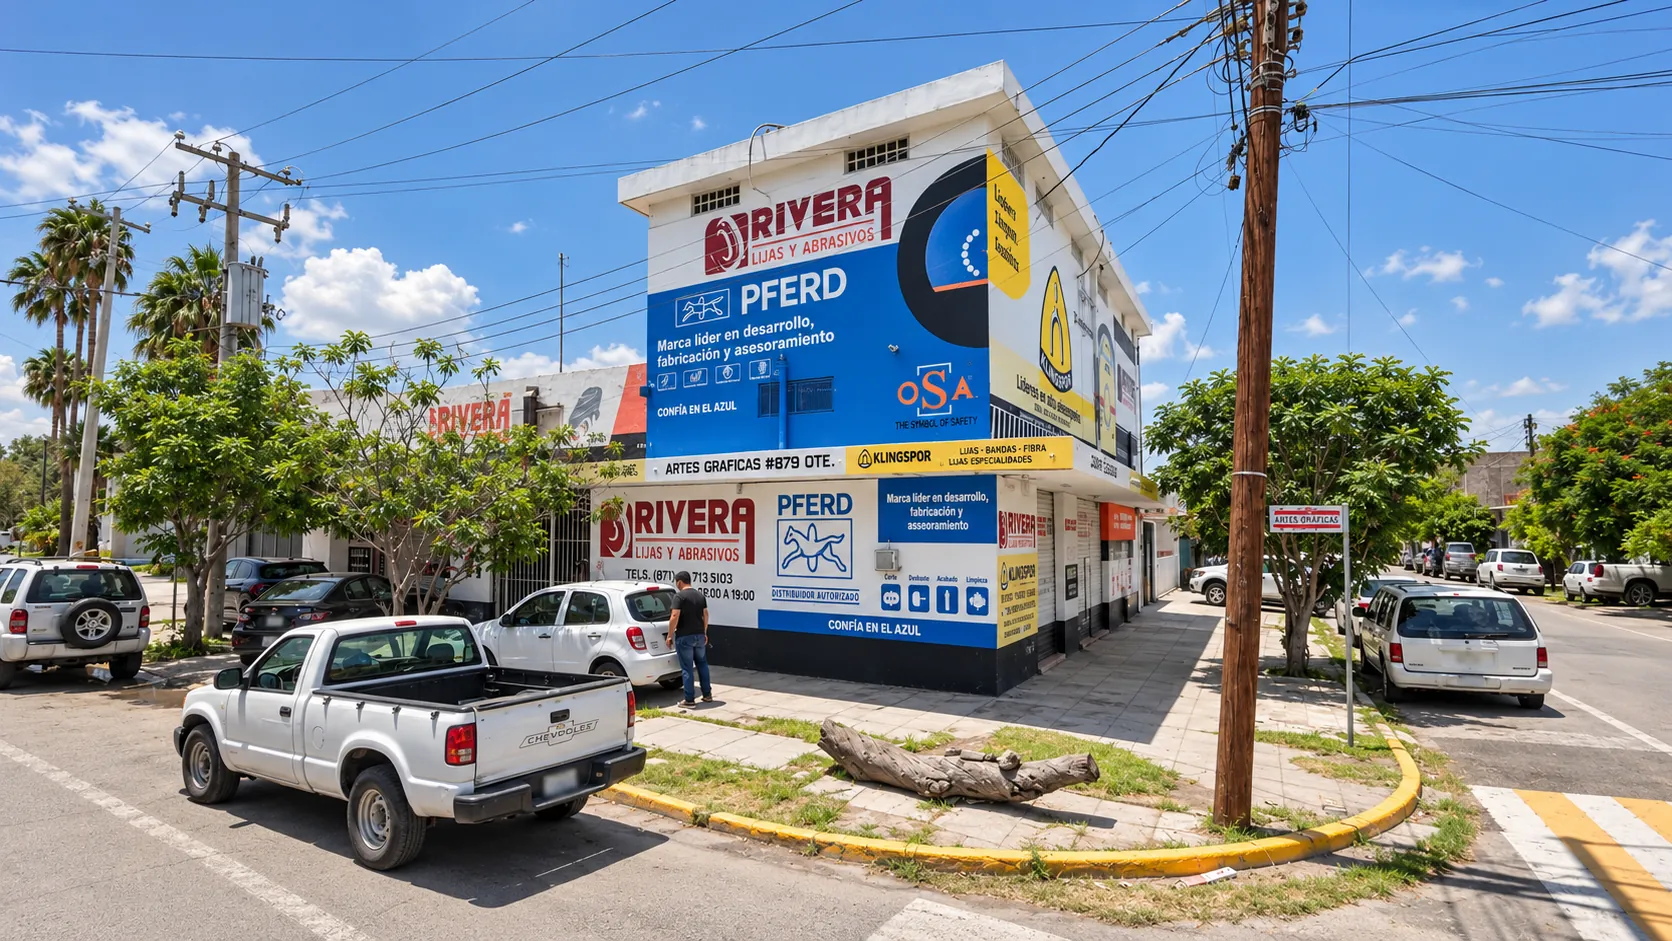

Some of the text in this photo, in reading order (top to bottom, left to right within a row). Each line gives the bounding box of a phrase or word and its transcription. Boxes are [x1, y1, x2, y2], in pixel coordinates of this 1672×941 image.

[751, 176, 892, 241] RIVERA
[752, 227, 875, 266] LIJAS Y ABRASIVOS
[741, 267, 848, 315] PFERD
[657, 337, 692, 352] Marca
[724, 330, 739, 341] en
[743, 316, 815, 338] desarrollo,
[657, 330, 835, 368] fabricación y asesoramiento
[657, 400, 737, 418] CONFÍA EN EL AZUL
[895, 416, 978, 430] THE SYMBOL OF SAFETY
[873, 450, 932, 465] KLINGSPOR
[985, 445, 1017, 454] BANDAS
[1023, 444, 1047, 453] FIBRA
[665, 454, 835, 475] ARTES GRAFICAS #879 OTE.
[970, 455, 1033, 465] ESPECIALIDADES
[777, 493, 853, 516] PFERD
[887, 493, 911, 503] Marca
[932, 494, 942, 503] en
[944, 491, 989, 503] desarrollo,
[910, 506, 963, 518] fabricación y
[635, 498, 755, 564] RIVERA
[1008, 512, 1036, 548] RIVERA
[636, 546, 739, 562] LIJAS Y ABRASIVOS
[625, 568, 651, 581] TELS.
[692, 571, 708, 583] 713
[723, 588, 730, 599] A
[731, 589, 755, 601] 19:00
[772, 589, 859, 601] DISTRIBUIDOR AUTORIZADO
[828, 618, 921, 636] CONFÍA EN EL AZUL
